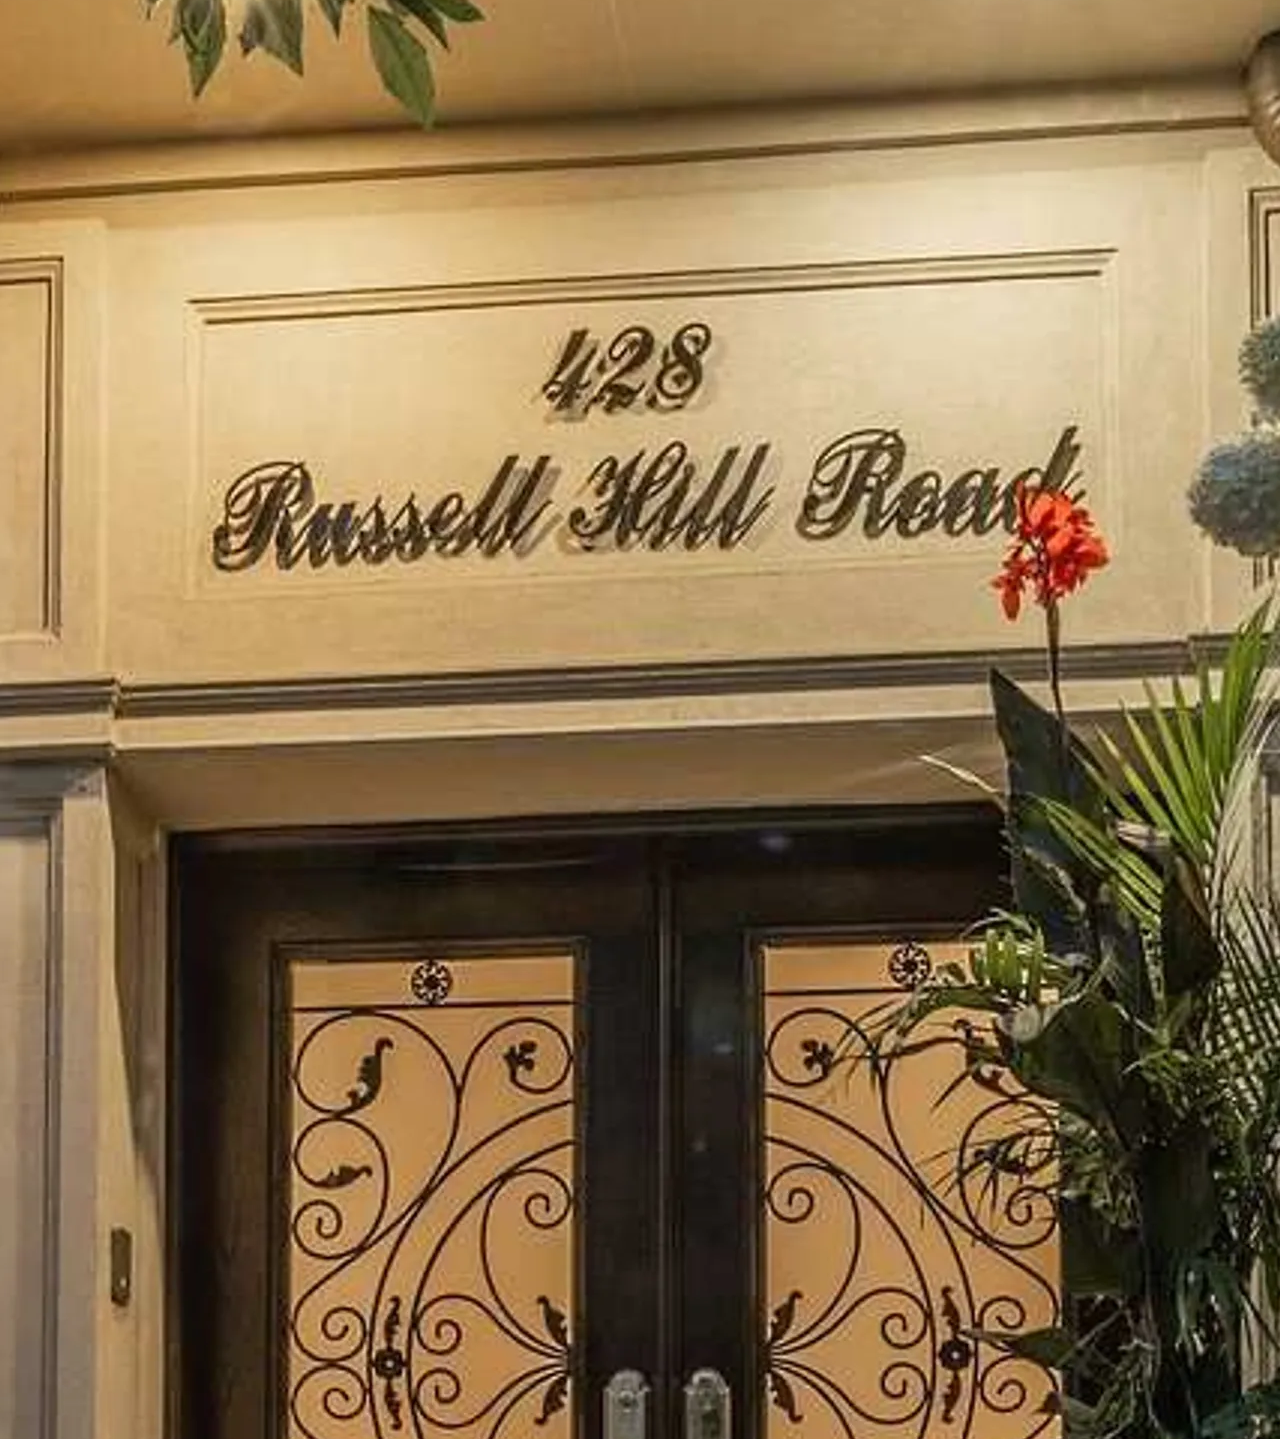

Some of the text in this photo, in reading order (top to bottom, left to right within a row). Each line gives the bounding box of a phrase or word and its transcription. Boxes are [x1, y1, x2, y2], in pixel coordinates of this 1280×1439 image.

[541, 321, 712, 414] 428
[213, 454, 554, 572] Russell
[569, 440, 776, 553] Hill
